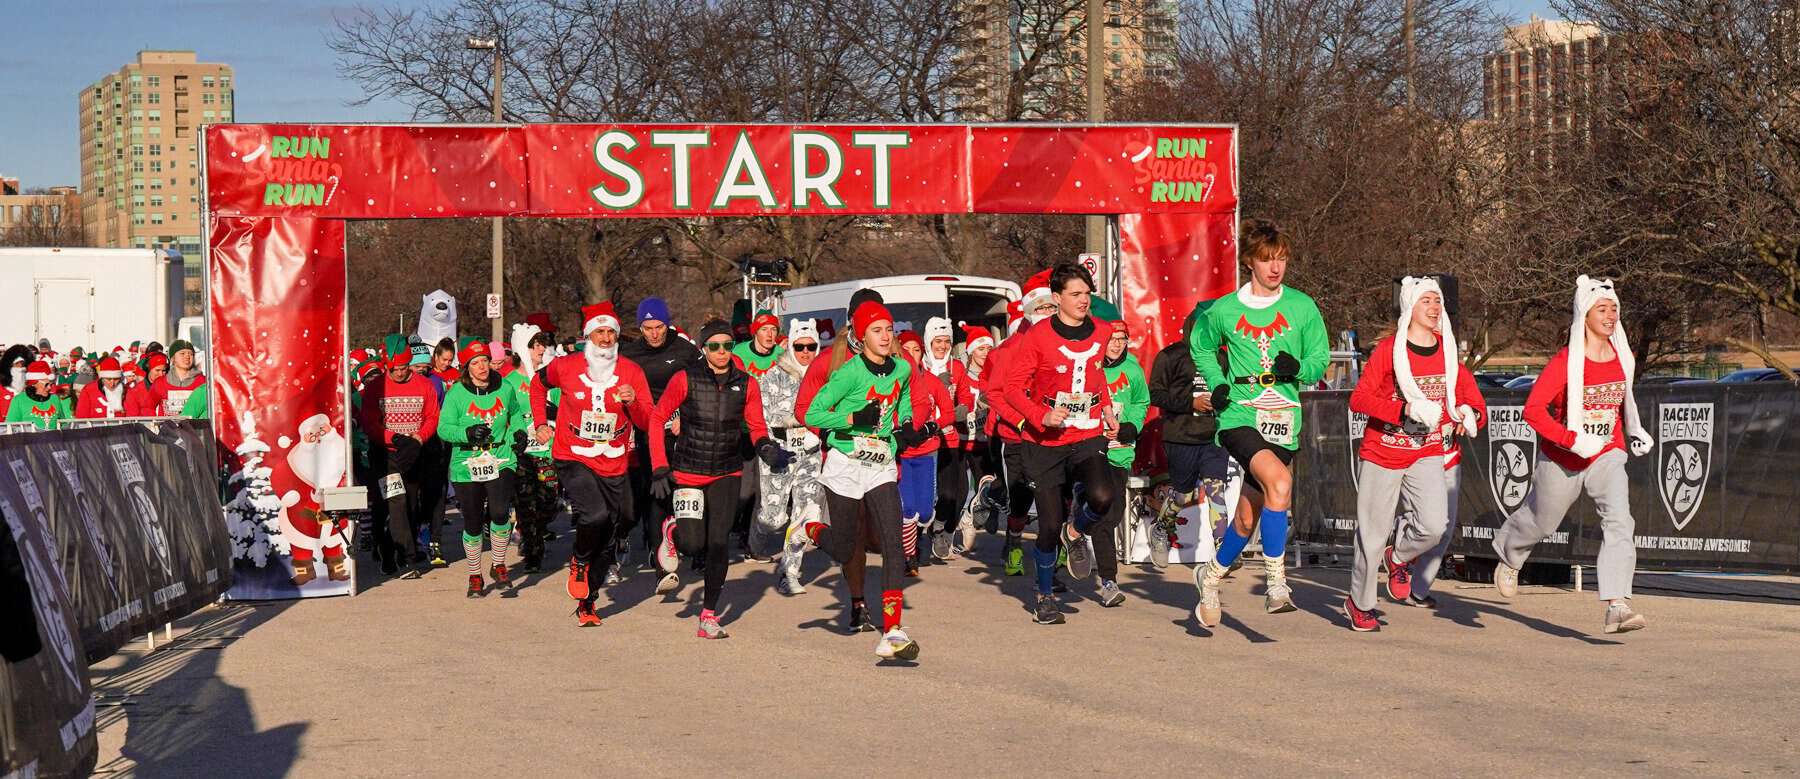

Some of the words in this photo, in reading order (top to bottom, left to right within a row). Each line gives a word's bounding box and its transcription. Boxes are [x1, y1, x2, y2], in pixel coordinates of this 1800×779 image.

[271, 136, 330, 159] RUN
[1156, 137, 1207, 159] RUN
[243, 150, 343, 186] Santa
[591, 129, 910, 209] START
[1132, 148, 1218, 185] Santa
[264, 183, 325, 206] RUN
[1151, 182, 1203, 203] RUN
[1351, 412, 1369, 422] RAC
[1490, 410, 1511, 423] RACE
[1662, 407, 1689, 422] RACE
[1691, 407, 1711, 421] DAY
[585, 421, 611, 434] 3164
[1261, 422, 1289, 436] 2795
[1489, 423, 1532, 438] EVENTS
[1583, 423, 1610, 436] 3128
[1661, 422, 1709, 438] EVENTS
[856, 450, 886, 464] 2749
[472, 465, 494, 476] 3163
[675, 500, 699, 512] 2318
[1335, 518, 1354, 530] MAKE
[1462, 526, 1472, 538] WE
[1473, 526, 1492, 539] MAKE
[1634, 536, 1657, 549] MAKE
[1658, 536, 1703, 551] WEEKENDS
[1704, 538, 1751, 553] AWESOME!
